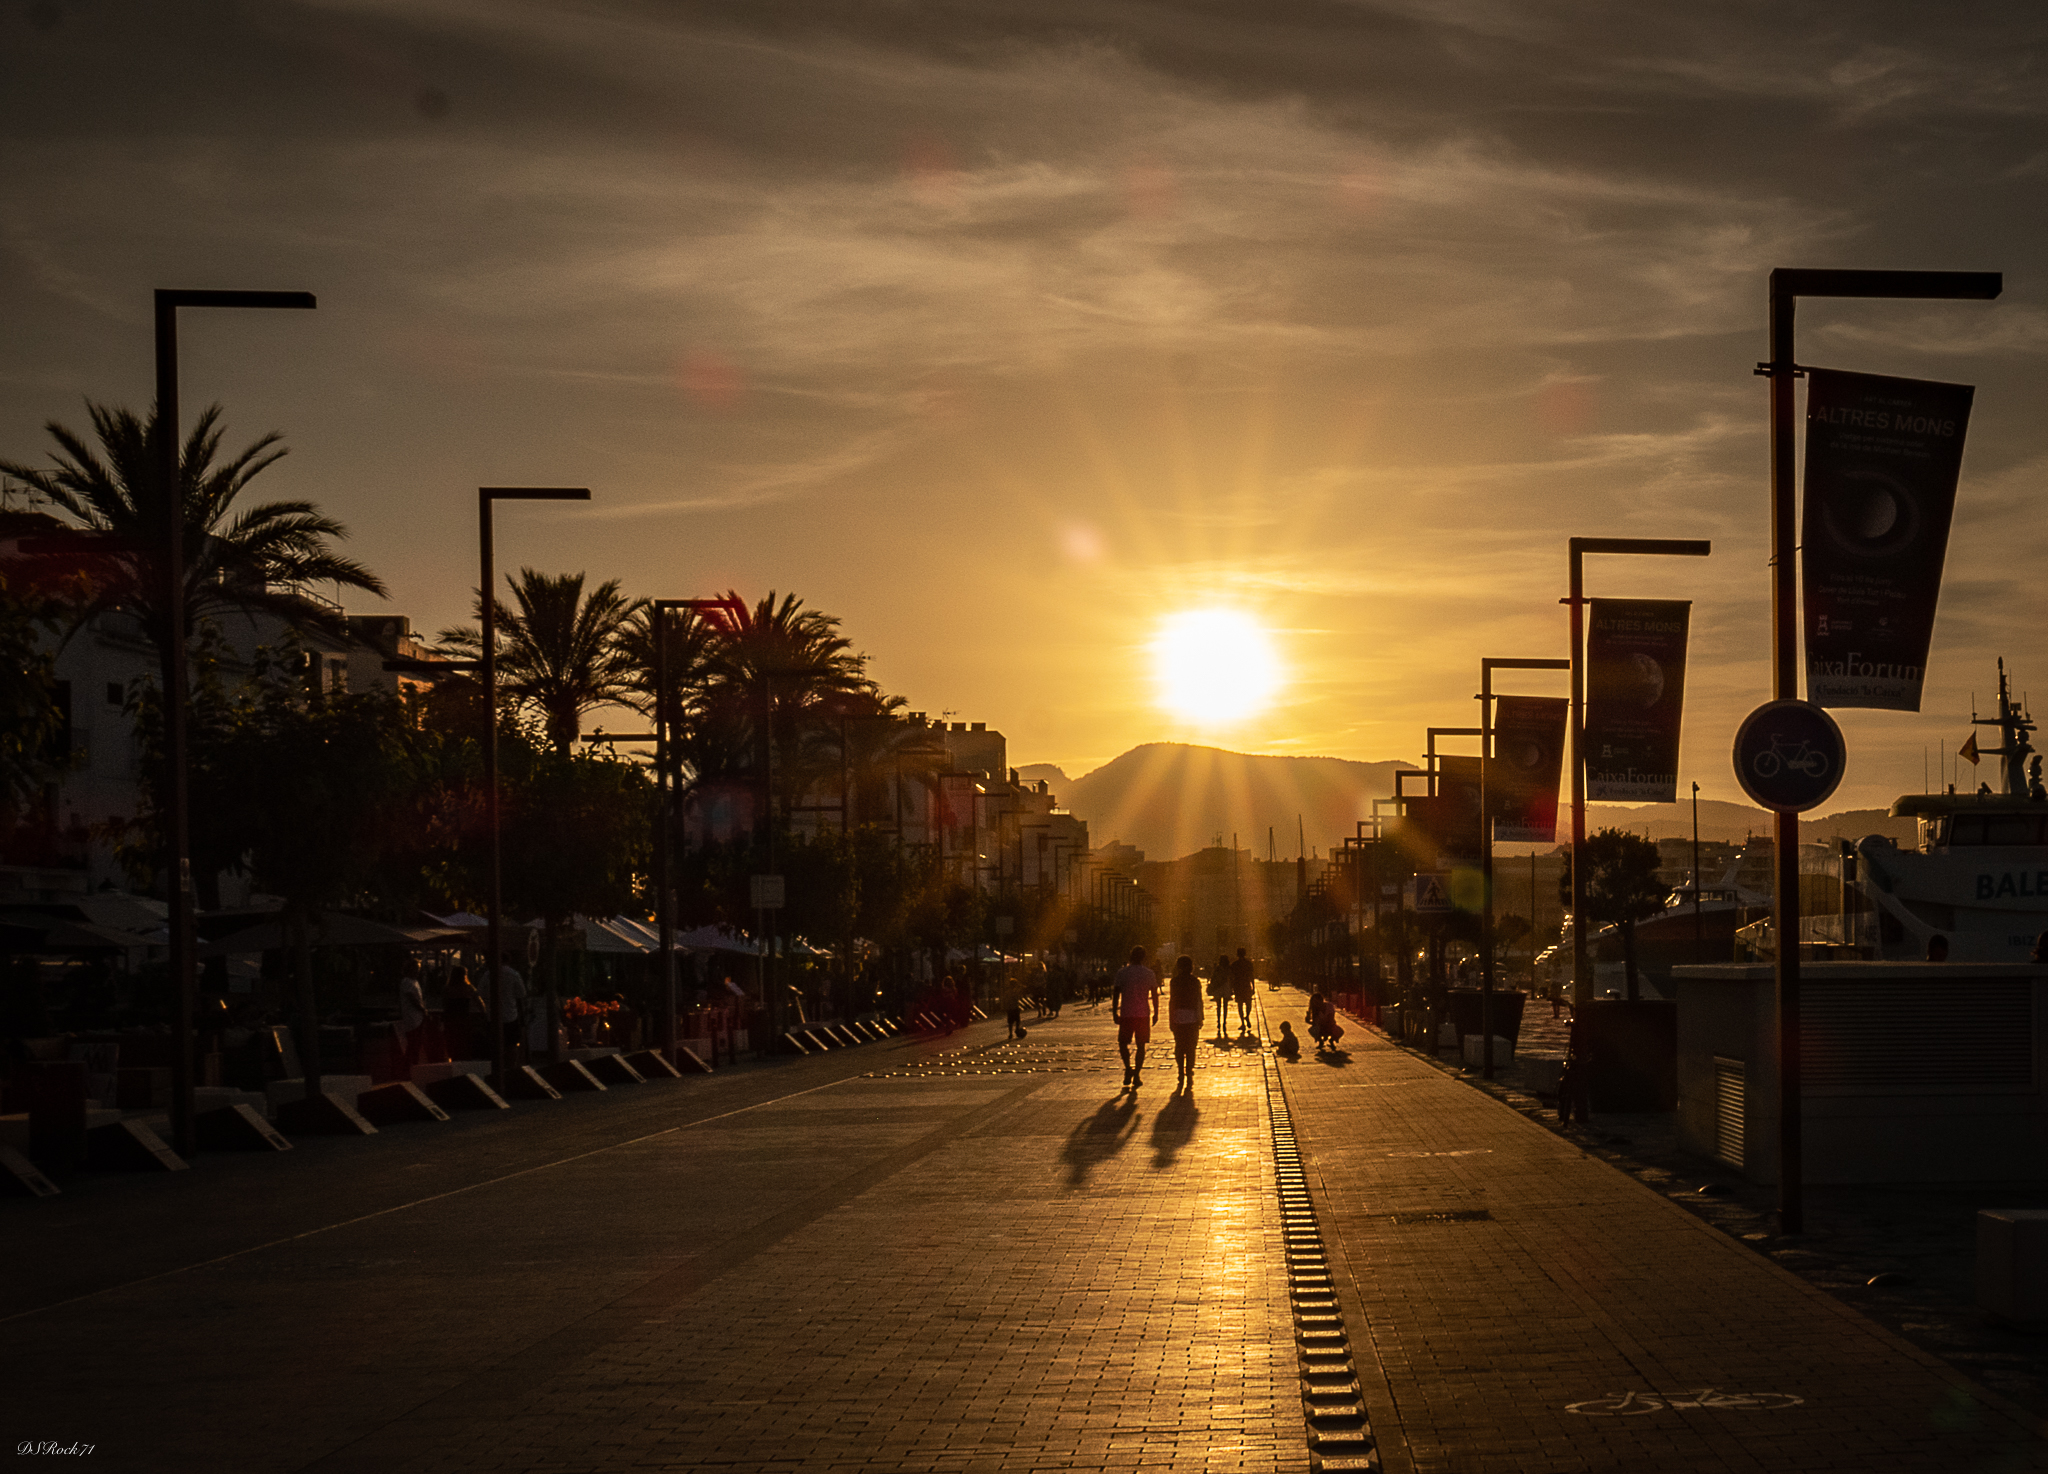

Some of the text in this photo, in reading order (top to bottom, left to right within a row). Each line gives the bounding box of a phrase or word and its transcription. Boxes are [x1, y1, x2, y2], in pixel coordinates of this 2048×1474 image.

[1815, 404, 1956, 438] ALTRES MONS
[1596, 618, 1681, 633] ALTRES MONS
[1587, 766, 1675, 784] CaixaForum
[1976, 871, 2048, 900] BALE
